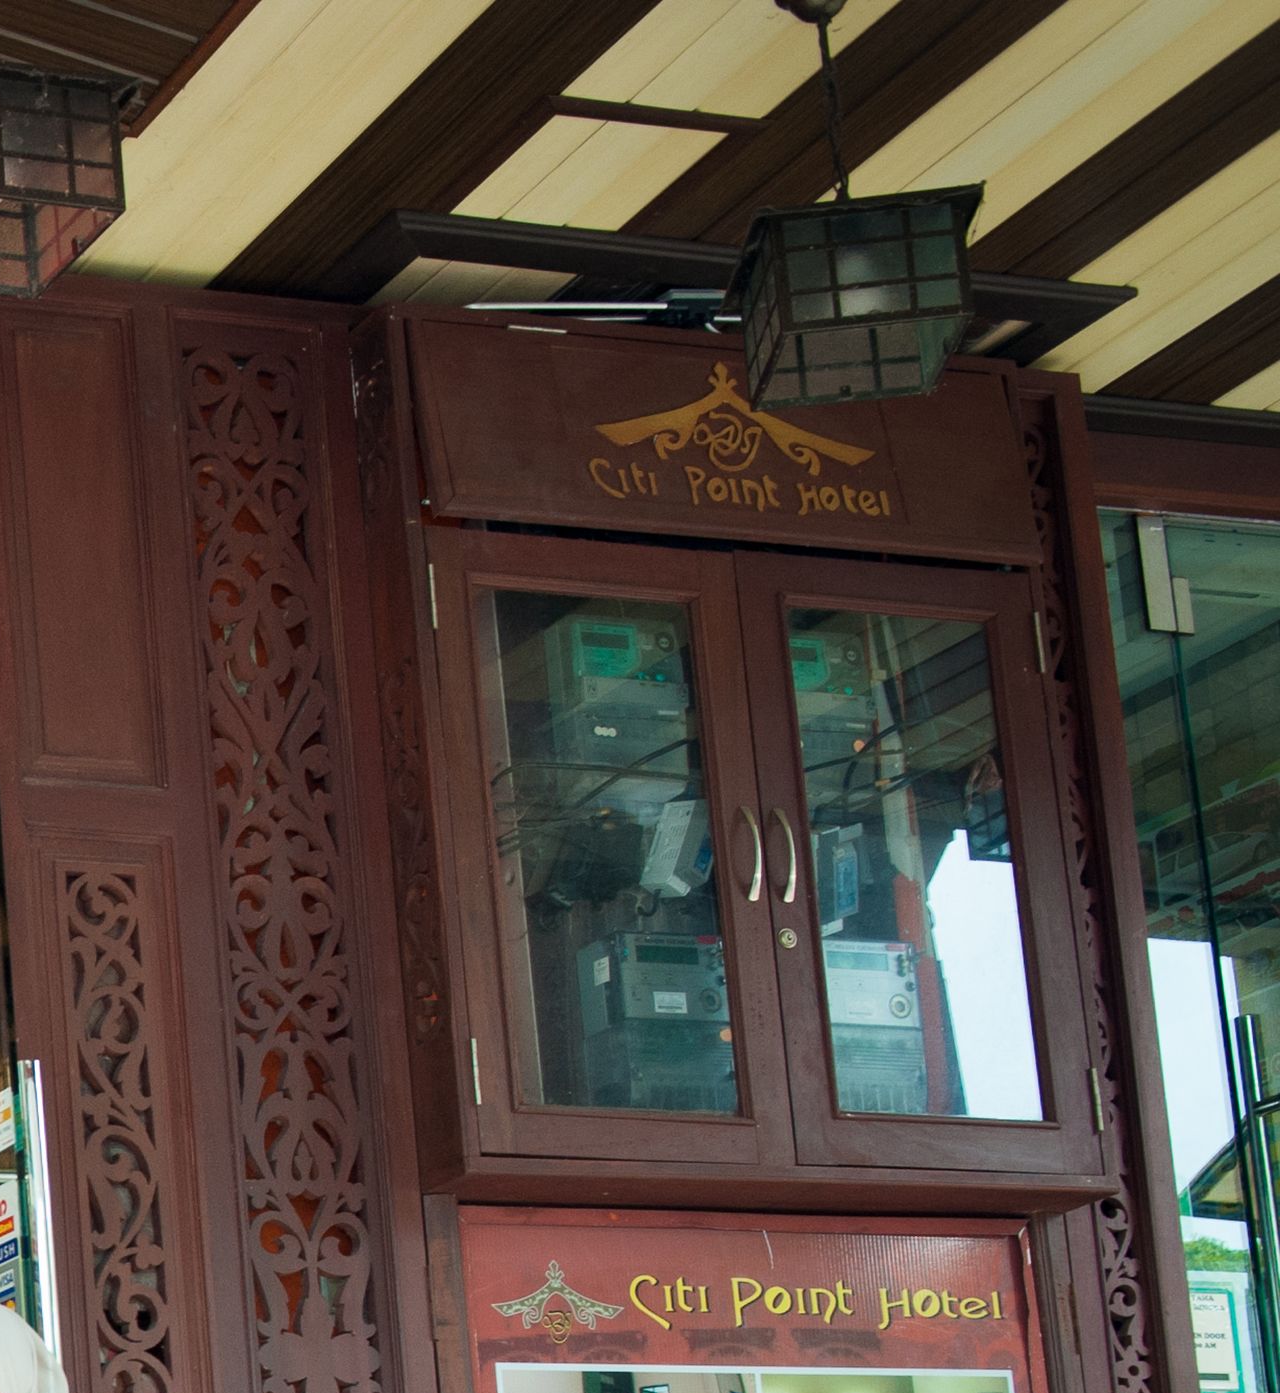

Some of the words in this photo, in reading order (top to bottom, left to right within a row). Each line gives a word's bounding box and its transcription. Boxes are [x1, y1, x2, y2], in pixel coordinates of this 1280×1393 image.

[589, 458, 660, 499] Citi
[684, 465, 781, 513] Point
[797, 482, 890, 516] Hotel
[0, 1270, 14, 1288] VISA
[628, 1273, 709, 1331] Citi
[731, 1276, 855, 1328] Point
[877, 1284, 1003, 1331] Hotel
